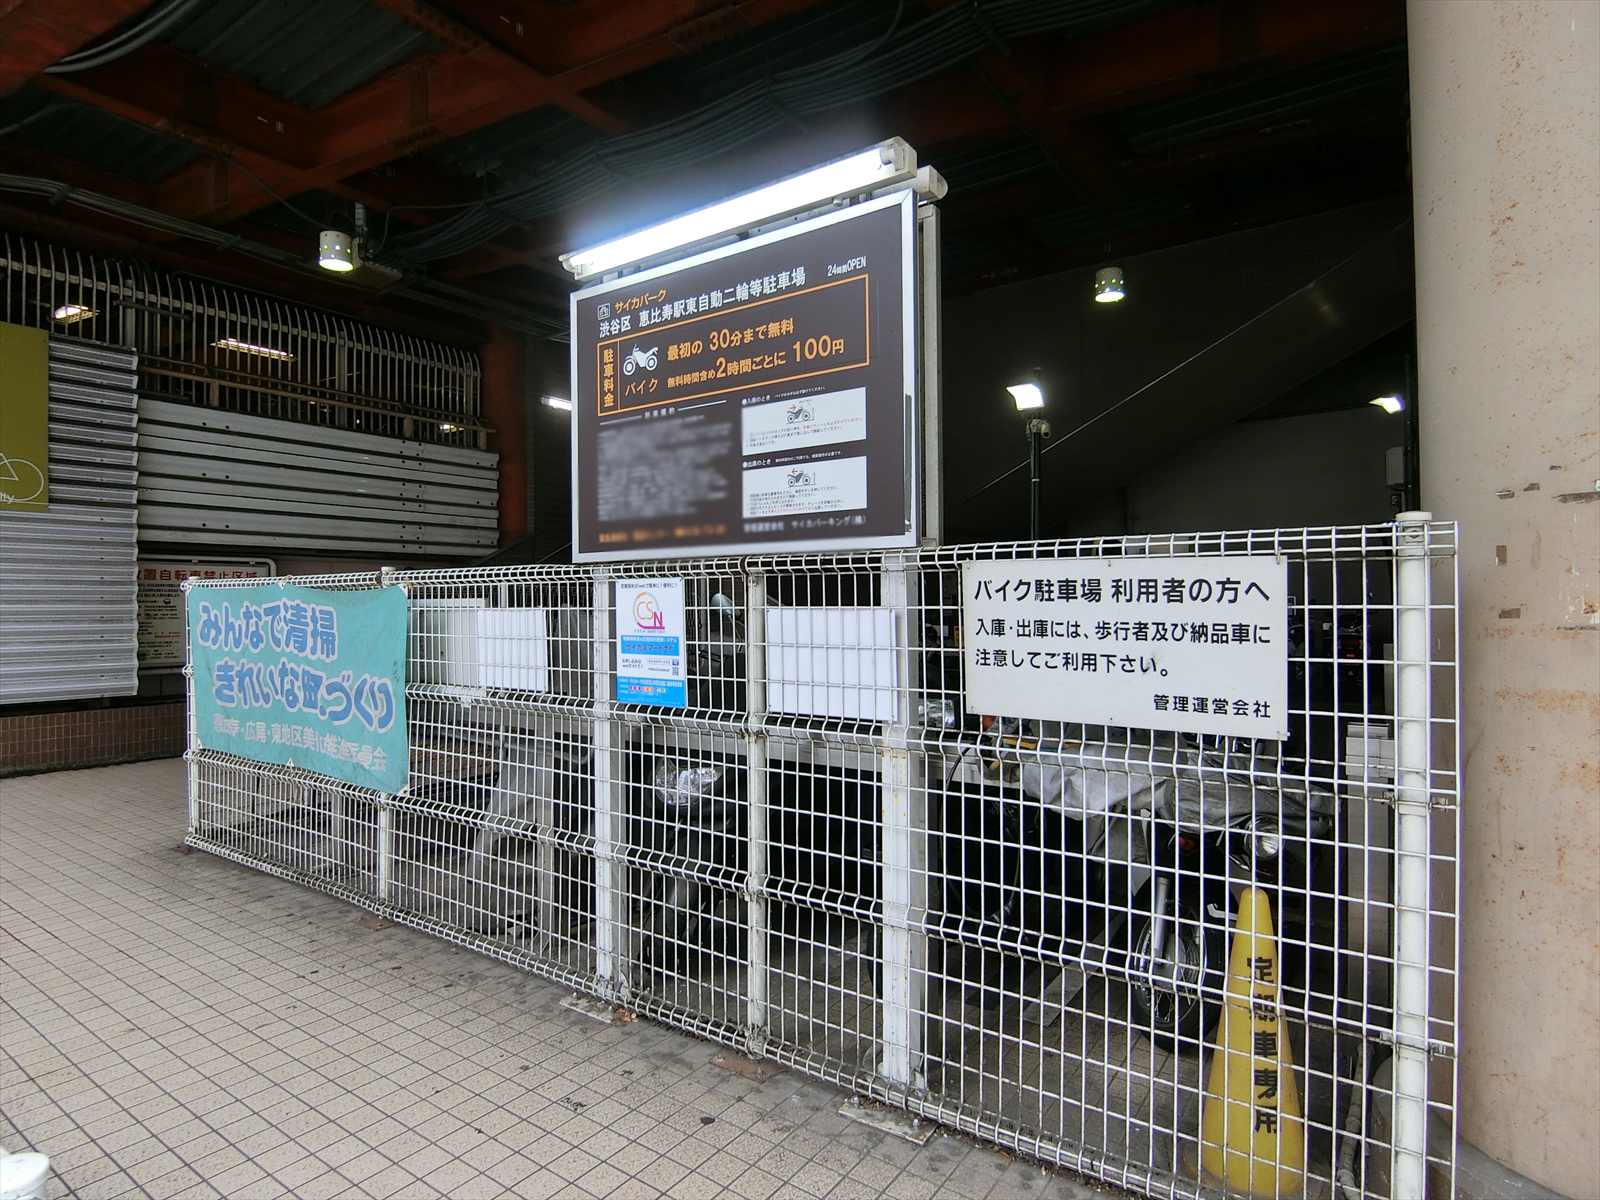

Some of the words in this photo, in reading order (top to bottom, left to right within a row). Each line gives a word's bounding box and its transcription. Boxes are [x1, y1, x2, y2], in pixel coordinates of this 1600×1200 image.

[827, 257, 867, 277] 24時間OPEN
[599, 315, 631, 338] 渋谷区
[638, 266, 806, 328] 恵比寿駅東自動二輪等駐車場
[614, 288, 667, 313] サイカパーク
[667, 339, 703, 362] 最初の
[709, 317, 794, 351] 30分まで無料
[667, 352, 786, 389] 無料時間含め2時間ごとに
[792, 335, 845, 363] 100円
[603, 349, 615, 408] 駐車料金
[625, 378, 659, 396] バイク
[136, 569, 257, 581] 置自転車禁止区域
[973, 578, 1102, 603] バイク駐車場
[1110, 577, 1271, 604] 利用者の方へ
[197, 598, 339, 663] みんなで清掃
[975, 618, 1271, 645] 入庫・出庫には、歩行者及び納品車に
[975, 648, 1169, 677] 注意してご利用下さい。
[212, 657, 396, 733] きれいな町づくり
[1153, 694, 1272, 719] 管理運営会社
